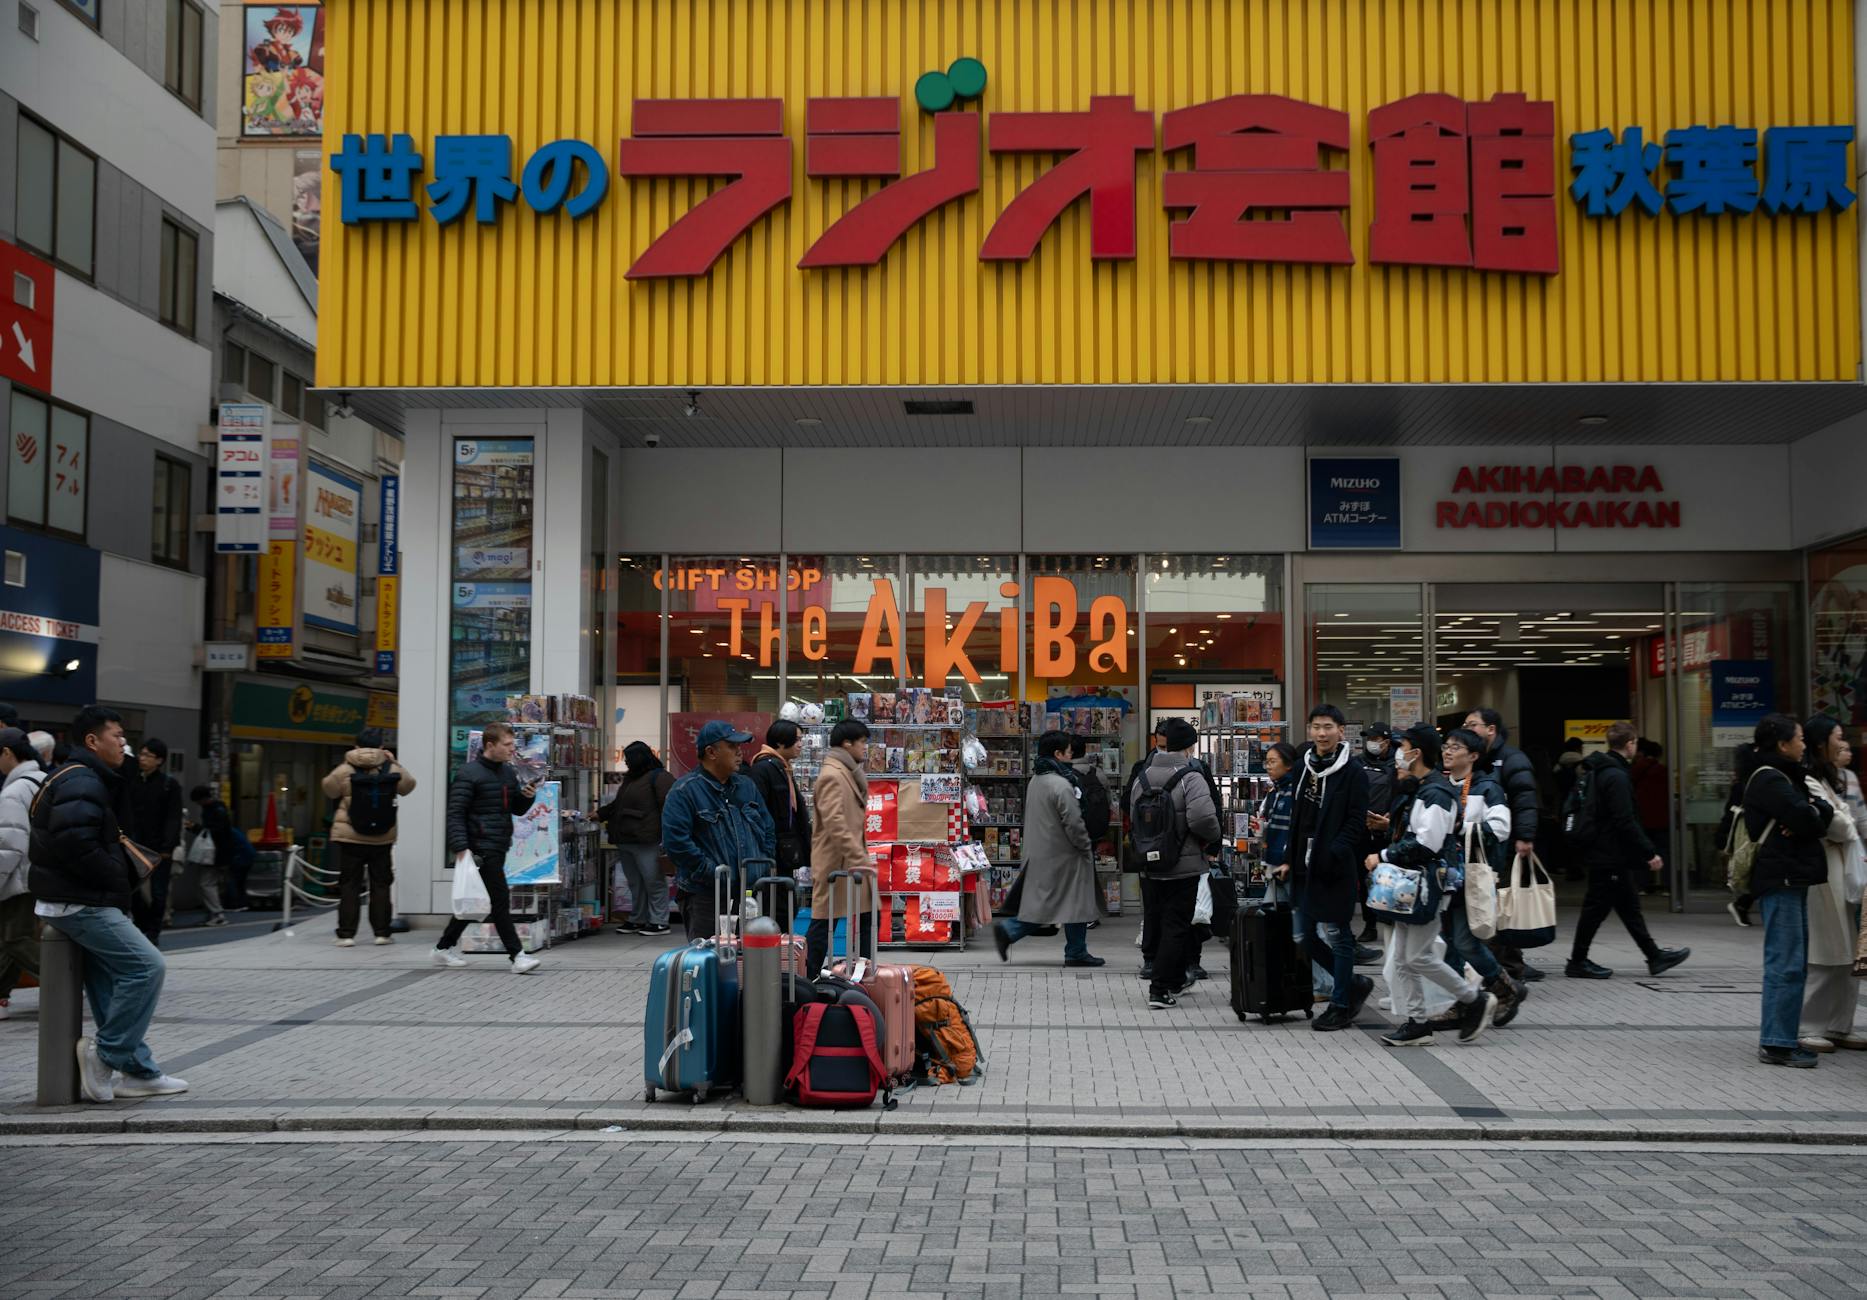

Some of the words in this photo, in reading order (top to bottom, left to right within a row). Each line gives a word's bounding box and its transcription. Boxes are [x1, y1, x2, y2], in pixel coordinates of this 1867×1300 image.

[330, 133, 609, 226] 世界の
[620, 57, 1560, 281] ラジオ会館
[1570, 124, 1857, 219] 秋葉原
[223, 450, 260, 462] アコム
[461, 444, 475, 456] 5F
[1330, 477, 1380, 489] MIZUHO
[1452, 465, 1663, 494] AKIHABARA
[1339, 500, 1371, 512] みずほ
[1436, 500, 1681, 529] RADIOKAIKAN
[1323, 513, 1389, 524] ATMコーナー
[653, 569, 725, 591] GIFT
[735, 569, 822, 592] SHOP
[458, 586, 474, 598] 5F
[0, 612, 41, 634] ACCESS
[46, 620, 80, 640] TICKET
[866, 794, 884, 833] 福袋
